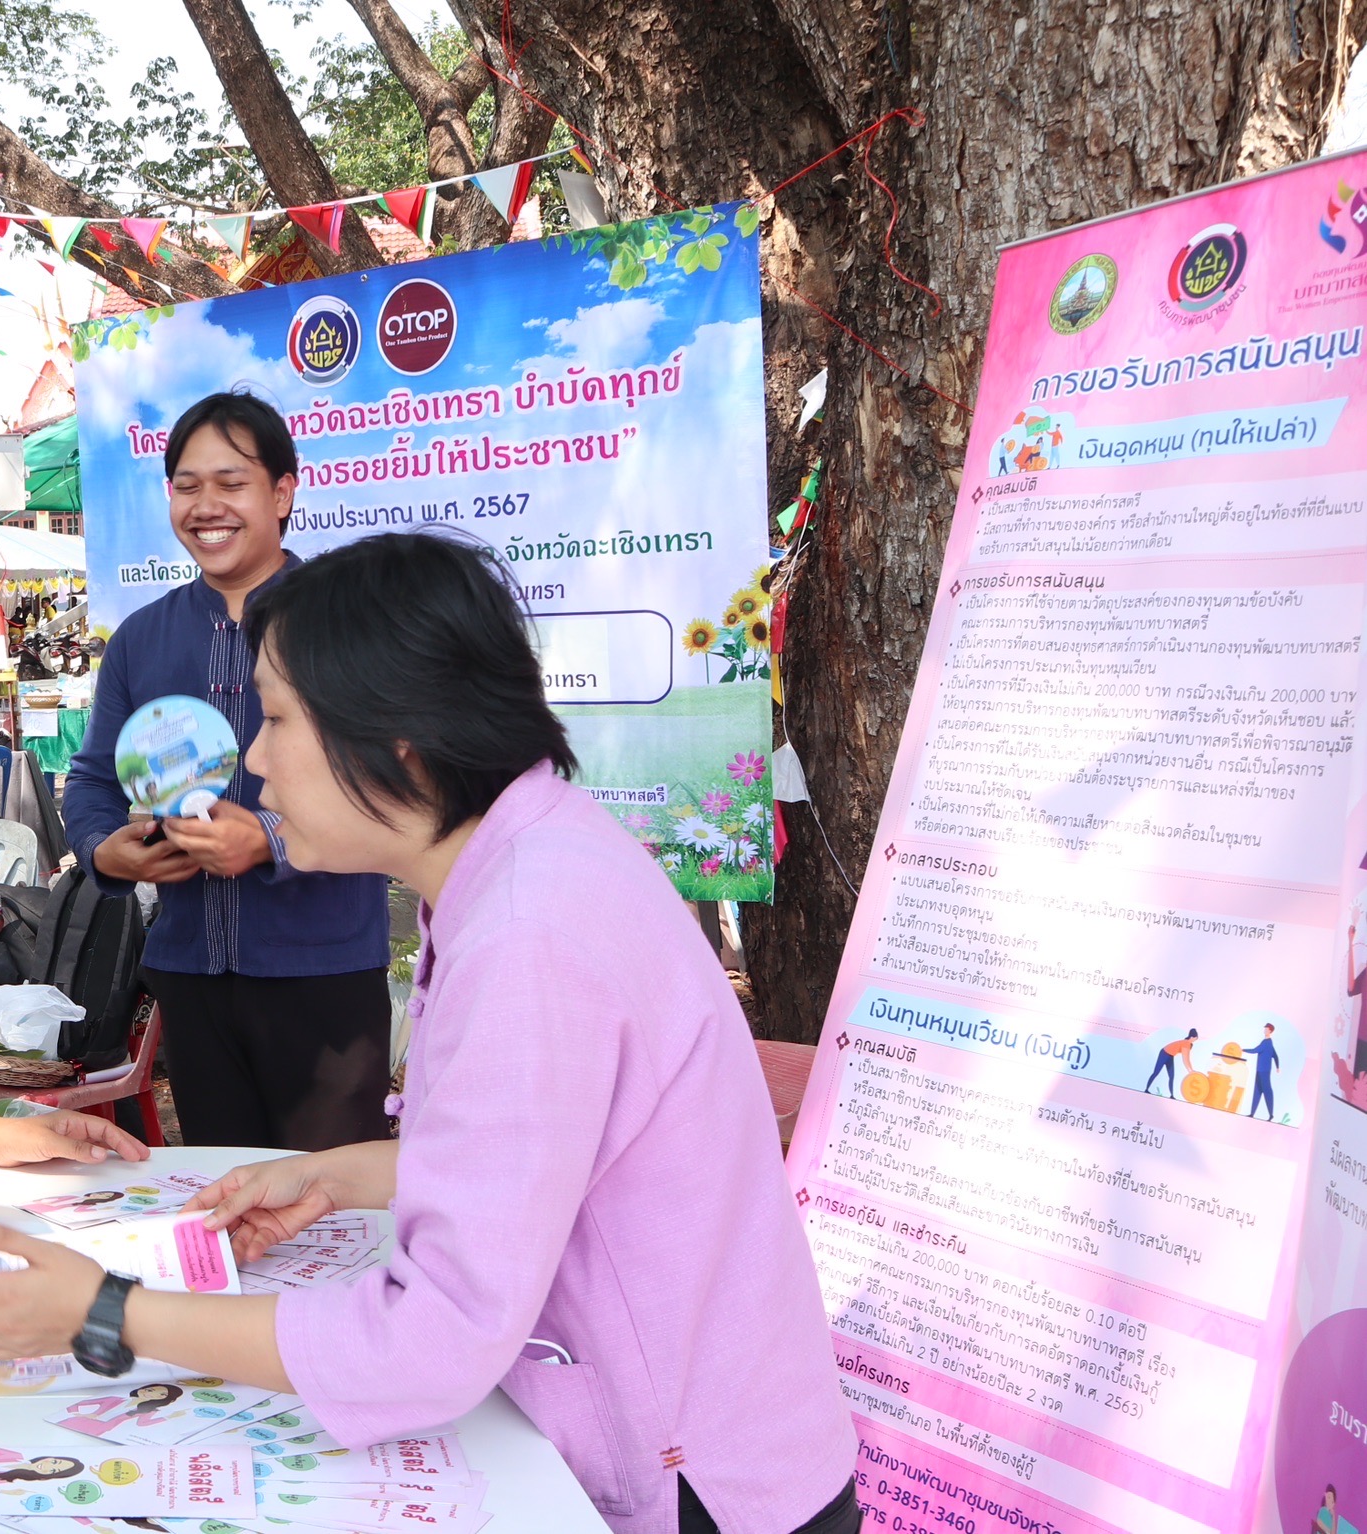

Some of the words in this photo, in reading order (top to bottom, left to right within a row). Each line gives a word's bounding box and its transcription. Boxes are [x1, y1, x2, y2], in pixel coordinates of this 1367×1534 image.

[1158, 285, 1247, 326] กรมการพัฒนาชุมชน
[385, 308, 448, 336] OTOP
[397, 337, 416, 345] Tambon
[428, 332, 448, 341] Product
[1031, 326, 1361, 401] การขอรับการสนับสนุน
[289, 387, 500, 437] หวัดฉะเชิงเทรา
[514, 354, 682, 410] บำบัดทุกข์
[1078, 432, 1185, 463] เงินอุดหนุน
[1191, 415, 1317, 454] (ทุนให้เปล่า)
[986, 478, 1037, 499] คุณสมบัติ
[421, 501, 465, 524] พ.ศ.
[473, 493, 530, 519] 2567
[988, 493, 1141, 517] เป็นสมาชิกประเภทองค์กรสตรี
[979, 535, 1172, 557] ขอรับการสนับสนุนไม่น้อยกว่าหกเดือน
[963, 572, 1105, 593] การขอรับการสนับสนุน
[961, 614, 1208, 634] คณะกรรมการบริหารกองทุนพัฒนาบทบาทสตรี
[951, 654, 1156, 679] ไม่เป็นโครงการประเภทเงินทุนหมุนเวียน
[1096, 683, 1141, 700] 200,000
[1145, 686, 1171, 699] บาท
[1176, 684, 1265, 703] กรณีวงเงินเกิน
[1271, 688, 1325, 705] 200,000
[1217, 757, 1325, 778] กรณีเป็นโครงการ
[897, 850, 998, 878] เอกสารประกอบ
[896, 893, 994, 924] ประเภทงบอุดหนุน
[880, 953, 1038, 998] สำเนาบัตรประจำตัวประชาชน
[869, 997, 1016, 1049] เงินทุนหมุนเวียน
[1024, 1032, 1091, 1070] (เงินกู้)
[854, 1036, 917, 1064] คุณสมบัติ
[842, 1120, 851, 1135] 6
[854, 1122, 913, 1152] เดือนขึ้นไป
[1038, 1102, 1095, 1133] รวมตัวกัน
[1098, 1121, 1107, 1135] 3
[1111, 1119, 1165, 1150] คนขึ้นไป
[814, 1193, 886, 1229] การขอกู้ยืม
[892, 1219, 967, 1257] และชำระคืน
[818, 1213, 909, 1260] โครงการละไม่เกิน
[912, 1249, 960, 1277] 200,000
[964, 1266, 990, 1287] บาท
[992, 1271, 1081, 1319] ดอกเบี้ยร้อยละ
[1084, 1308, 1115, 1332] 0.10
[1119, 1315, 1148, 1342] ต่อปี
[866, 1276, 899, 1304] วิธีการ
[835, 1354, 910, 1395] นอโครงการ
[916, 1345, 927, 1361] 2
[930, 1345, 940, 1366] ปี
[942, 1353, 1024, 1400] อย่างน้อยปีละ
[1026, 1386, 1037, 1404] 2
[1040, 1392, 1064, 1414] งวด
[1148, 1350, 1177, 1380] เรื่อง
[1074, 1378, 1100, 1403] พ.ศ.
[1105, 1394, 1144, 1421] 2563)
[936, 1418, 1037, 1482] ในพื้นที่ตั้งของผู้กู้
[189, 1453, 225, 1503] พลังสตรี
[877, 1480, 975, 1534] 0-3851-3460
